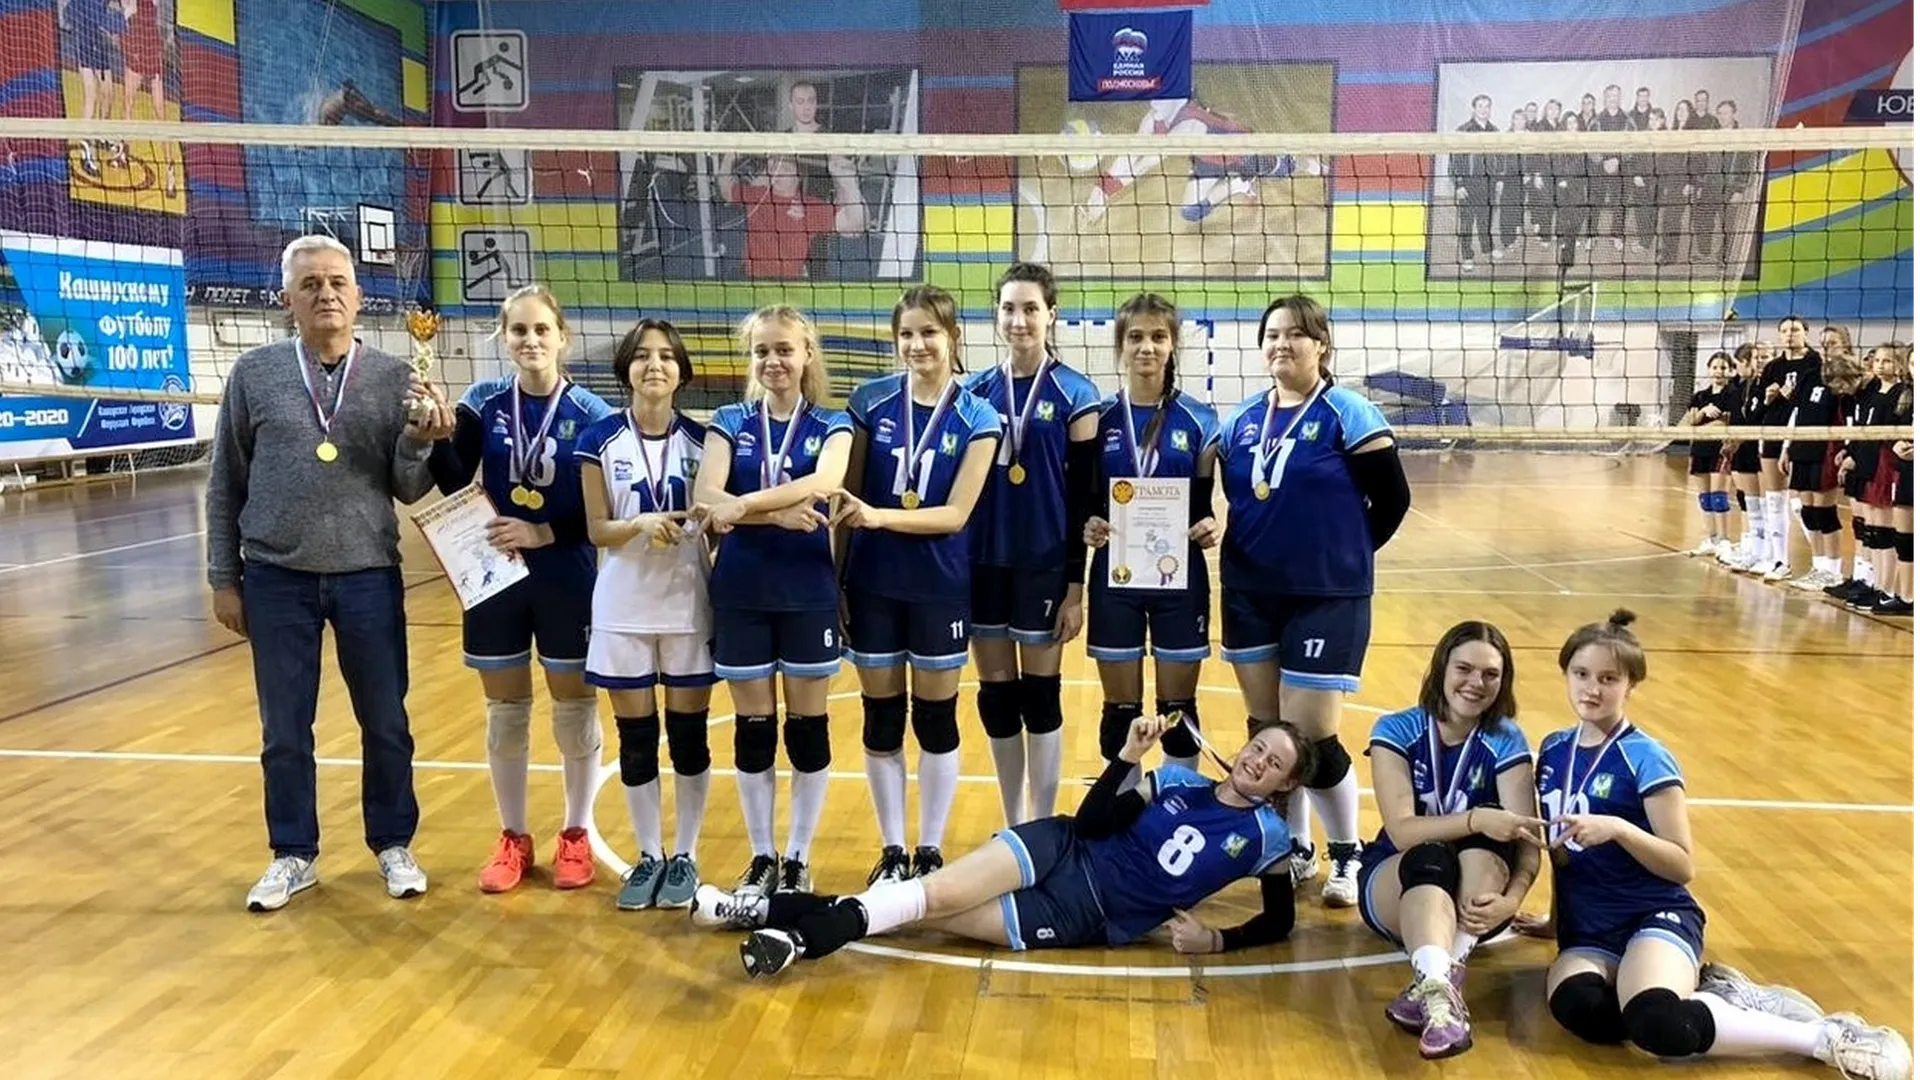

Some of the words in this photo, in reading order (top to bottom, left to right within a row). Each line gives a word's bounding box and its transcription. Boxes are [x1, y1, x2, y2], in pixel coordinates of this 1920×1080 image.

[59, 271, 169, 307] Каширскому
[108, 344, 139, 370] 100
[142, 344, 174, 370] лет!
[891, 447, 936, 502] 11
[1248, 438, 1297, 489] 17
[1044, 600, 1053, 617] 7
[823, 628, 833, 648] 6
[950, 620, 964, 639] 11
[1303, 638, 1325, 658] 17
[1157, 824, 1206, 877] 8
